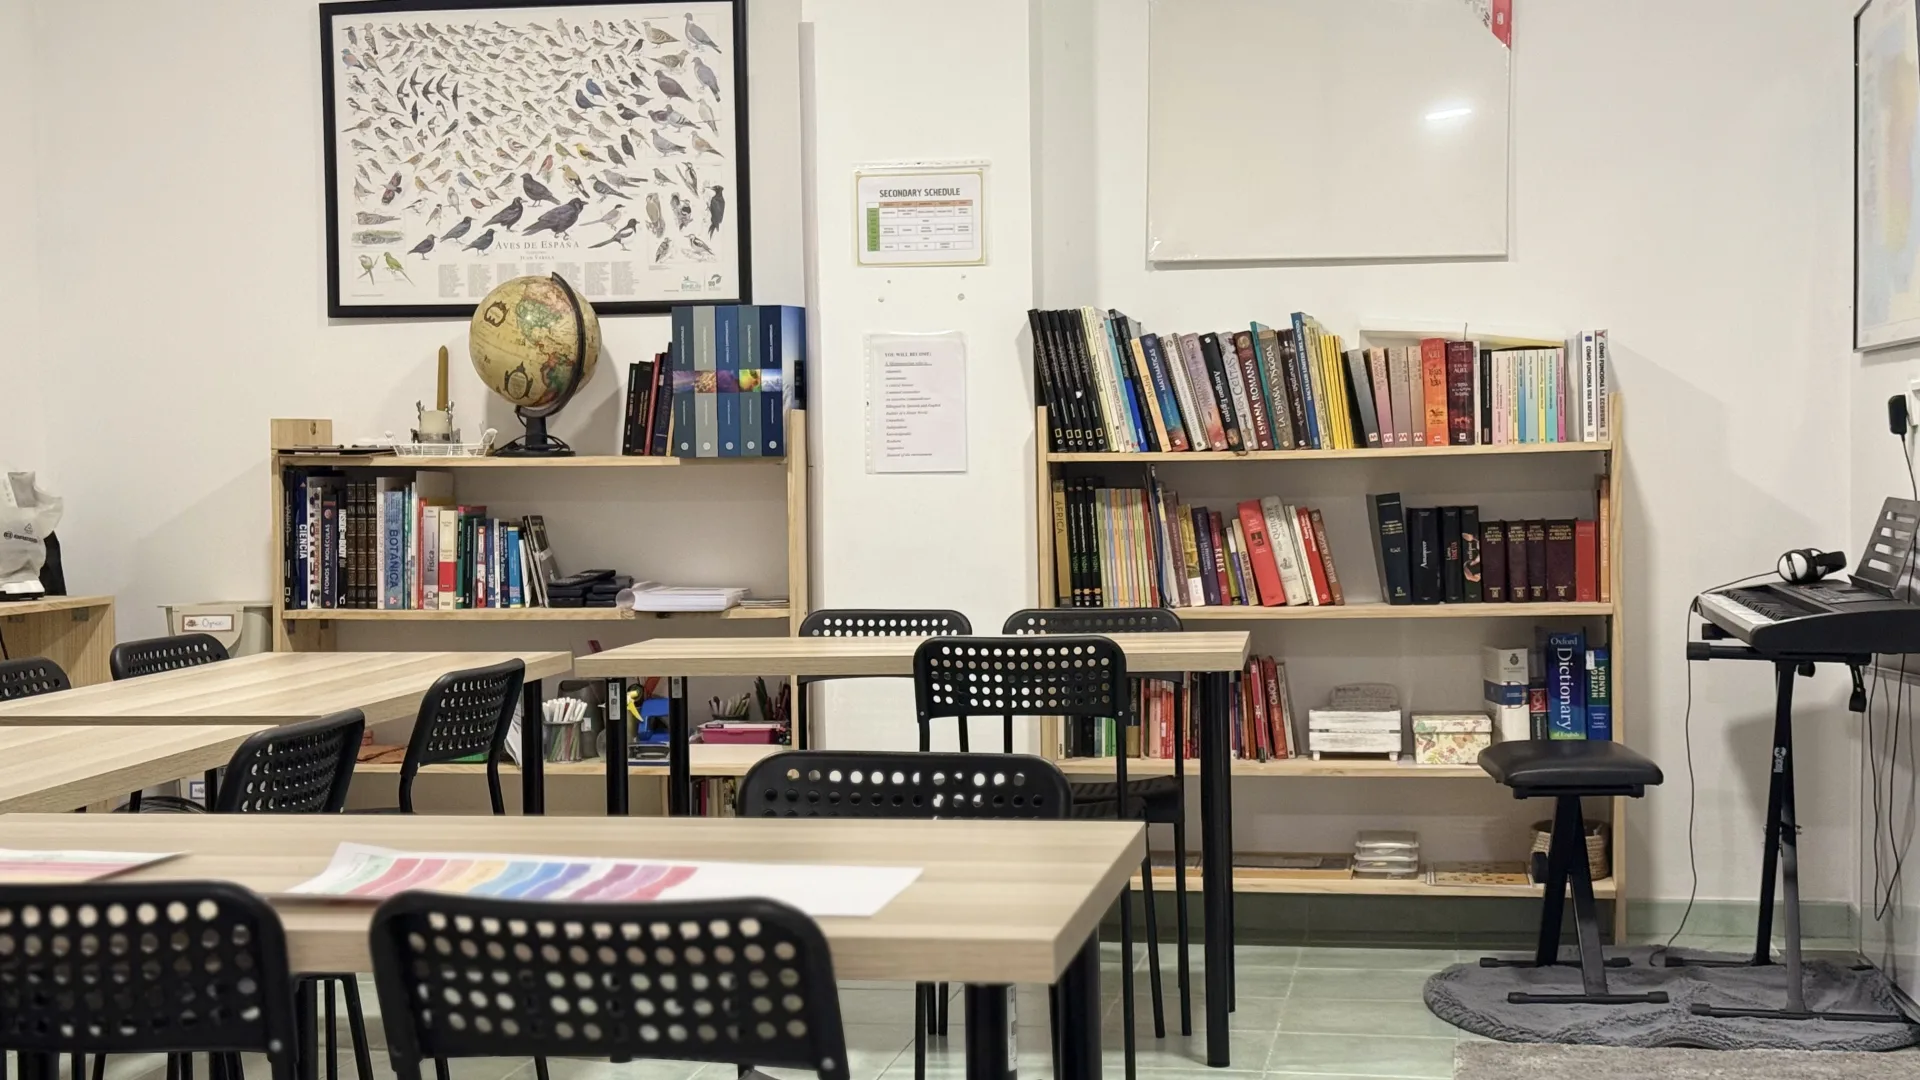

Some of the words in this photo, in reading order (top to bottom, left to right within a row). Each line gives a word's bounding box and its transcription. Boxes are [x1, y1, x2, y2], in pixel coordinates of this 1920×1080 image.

[879, 189, 922, 198] SECONDARY
[924, 188, 961, 196] SCHEDULE
[495, 241, 521, 249] AVES
[524, 241, 538, 249] DE
[541, 240, 580, 249] ESPAÑA
[1294, 319, 1302, 340] MUNDO
[1150, 348, 1166, 391] MATEMÁTICAS
[1265, 344, 1279, 384] VISIGODA
[1141, 374, 1154, 398] Madrid
[1212, 369, 1227, 398] Antiguo
[1244, 359, 1259, 400] ROMANA
[1219, 398, 1233, 422] Egipto
[1271, 385, 1283, 414] ESPAÑA
[1252, 401, 1266, 435] ESPAÑA
[1278, 416, 1285, 427] LA
[338, 508, 346, 531] INSIDE
[1264, 505, 1281, 540] QUIJOTE
[299, 524, 307, 558] CIENCIA
[338, 539, 346, 558] BODY
[388, 529, 400, 587] BOTÁNICA
[1551, 637, 1577, 645] Oxford
[1266, 678, 1277, 704] MOMO
[1532, 691, 1542, 710] VOX
[1556, 648, 1574, 730] Dictionary
